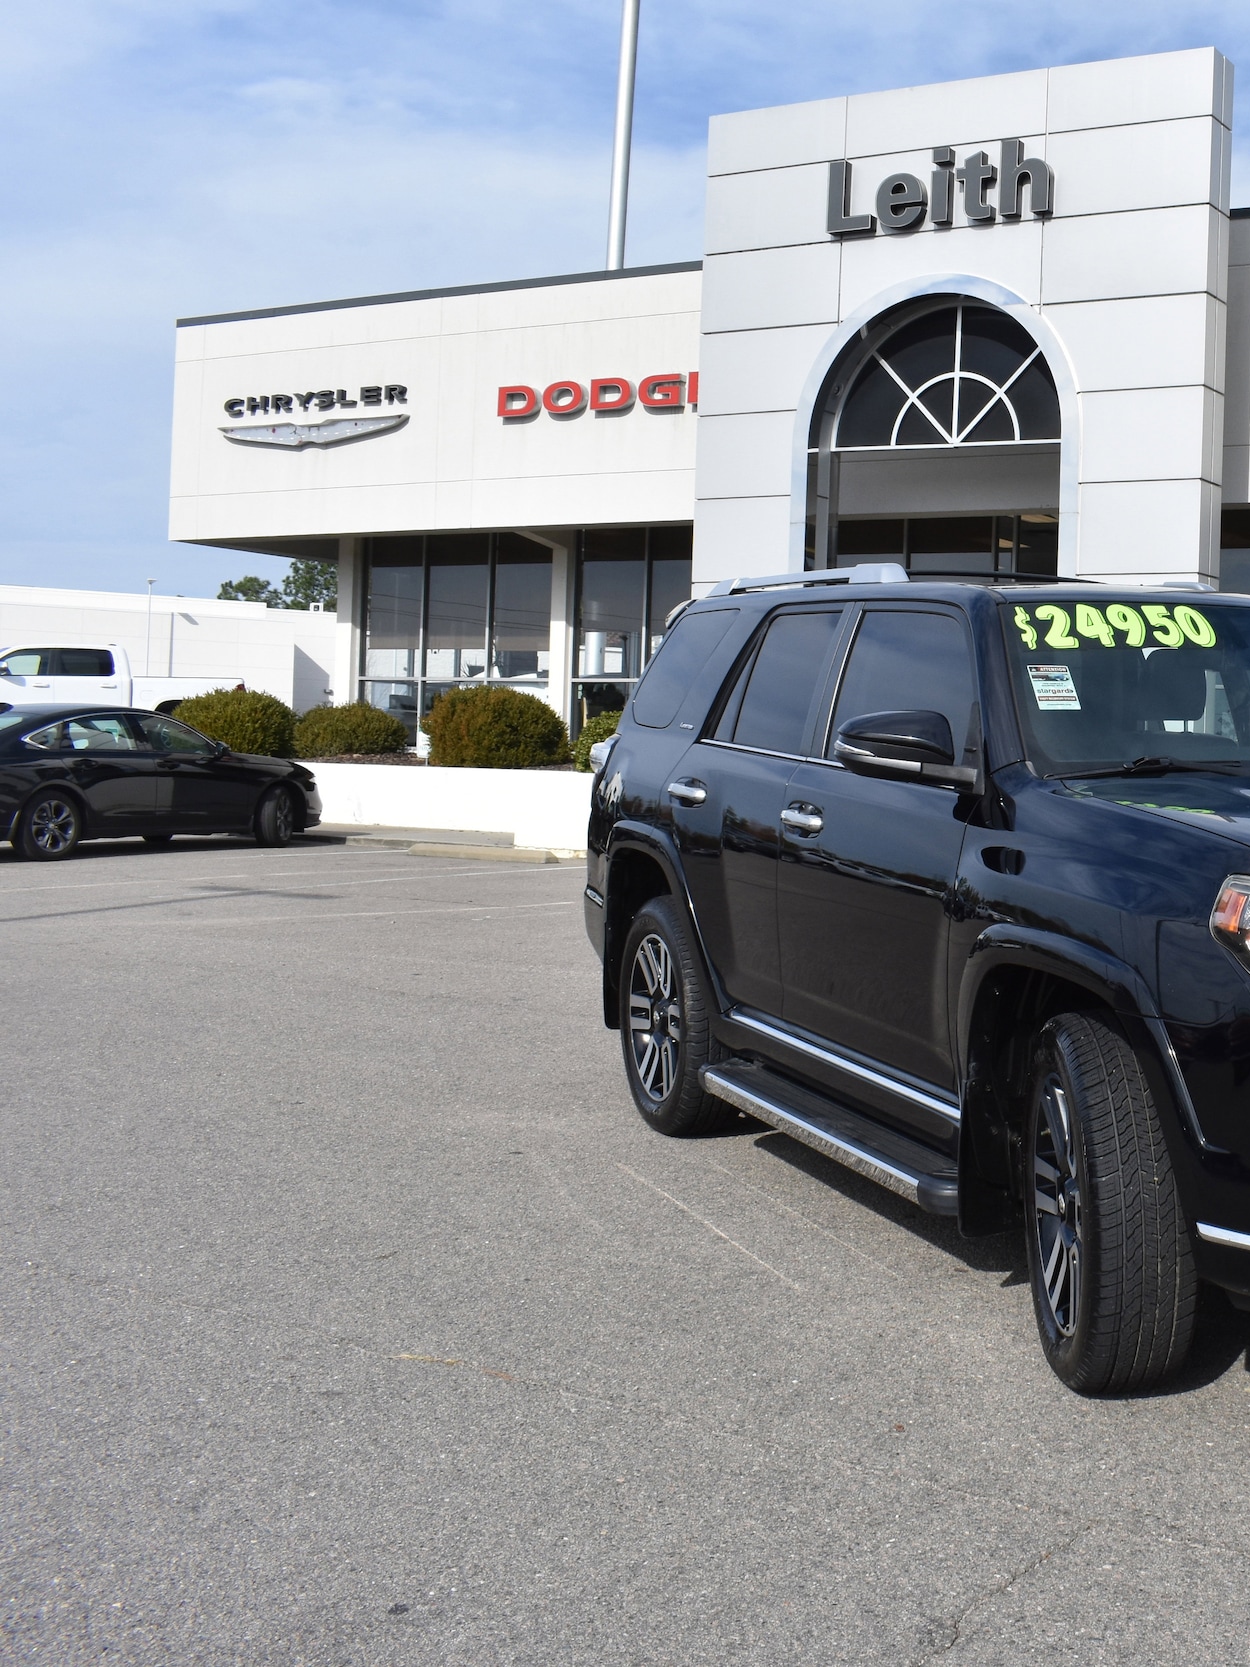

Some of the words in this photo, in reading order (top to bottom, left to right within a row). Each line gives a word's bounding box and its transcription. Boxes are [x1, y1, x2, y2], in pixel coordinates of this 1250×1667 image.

[826, 138, 1054, 235] Leith
[224, 384, 408, 417] CHRYSLER
[1014, 603, 1217, 650] $24950
